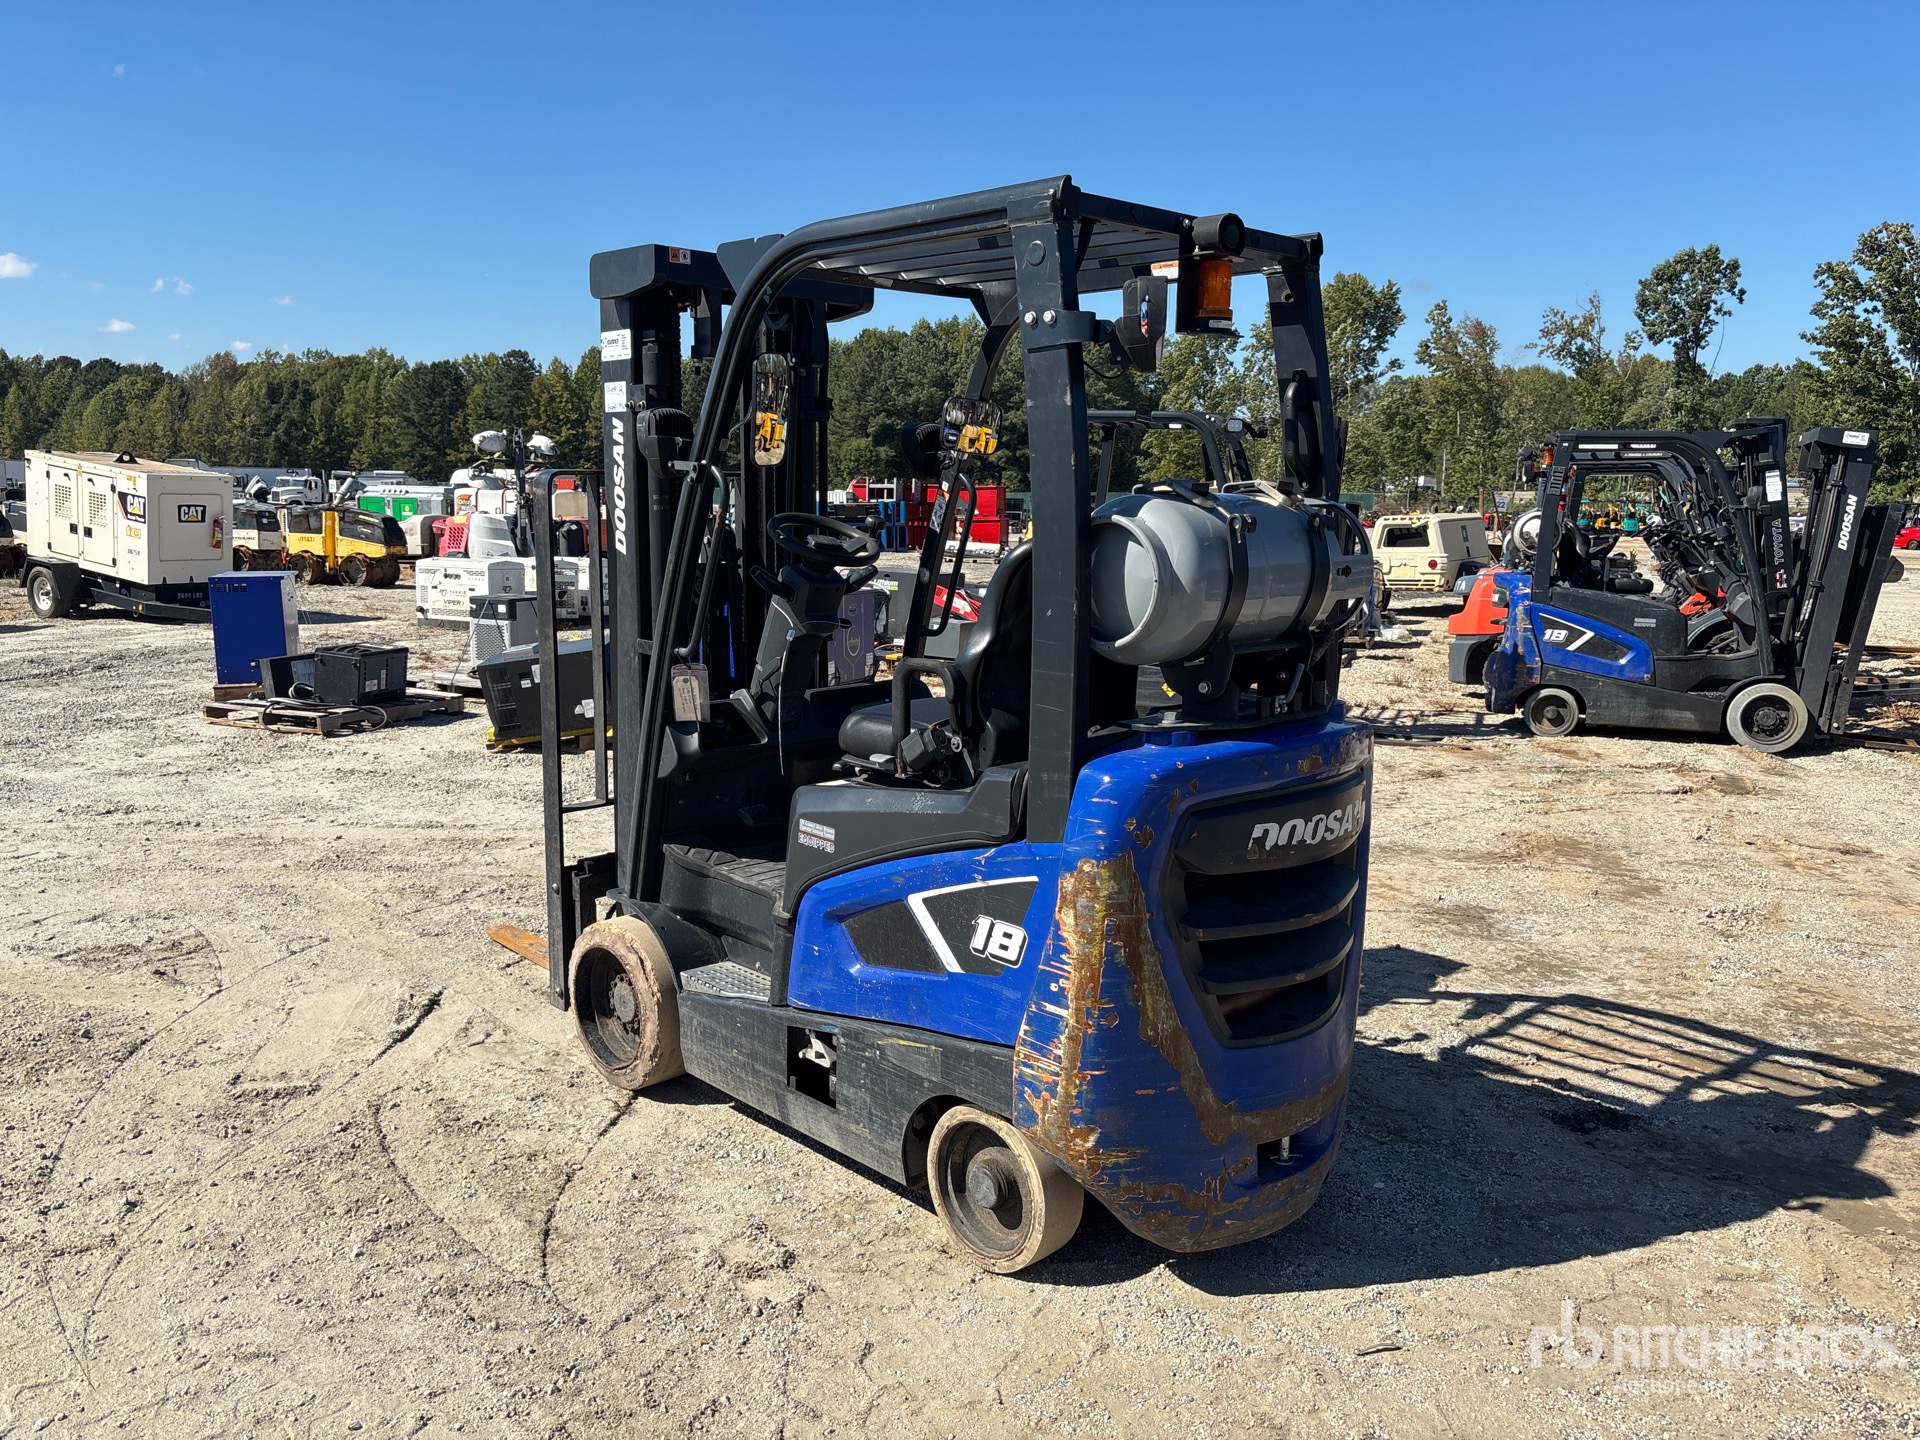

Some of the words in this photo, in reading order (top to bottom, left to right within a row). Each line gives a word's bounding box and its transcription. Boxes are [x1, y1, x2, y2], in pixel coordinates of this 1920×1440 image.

[612, 417, 627, 555] DOOSAN
[126, 494, 146, 515] CAT
[180, 506, 204, 522] CAT
[1496, 500, 1506, 509] 22
[1837, 494, 1858, 551] DOOSAN
[1771, 518, 1784, 565] TOYOTA
[873, 578, 899, 586] Lithium
[1542, 628, 1569, 643] 18
[797, 832, 836, 854] EQUIPPED
[970, 914, 1029, 968] 18
